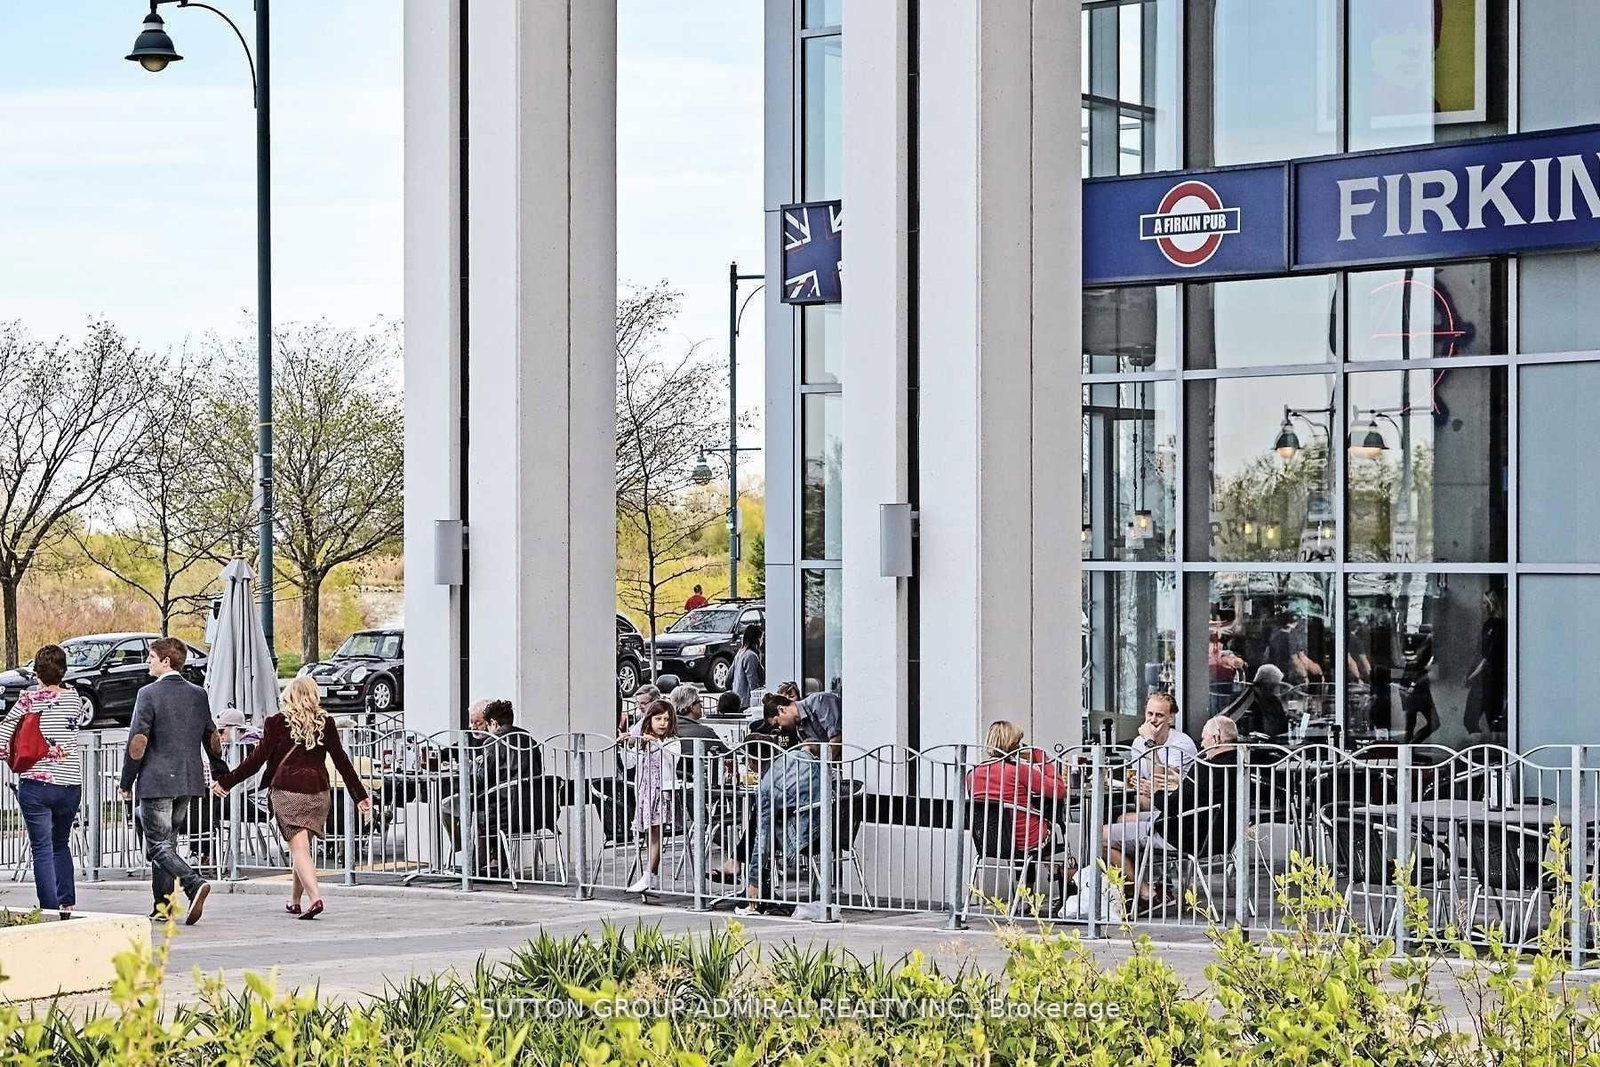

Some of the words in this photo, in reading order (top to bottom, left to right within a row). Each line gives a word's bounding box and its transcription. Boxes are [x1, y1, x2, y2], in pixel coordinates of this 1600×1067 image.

[1154, 218, 1162, 234] A
[1164, 215, 1200, 233] FIRKIN
[1203, 213, 1227, 230] PUB
[1337, 152, 1600, 241] FIRKIN
